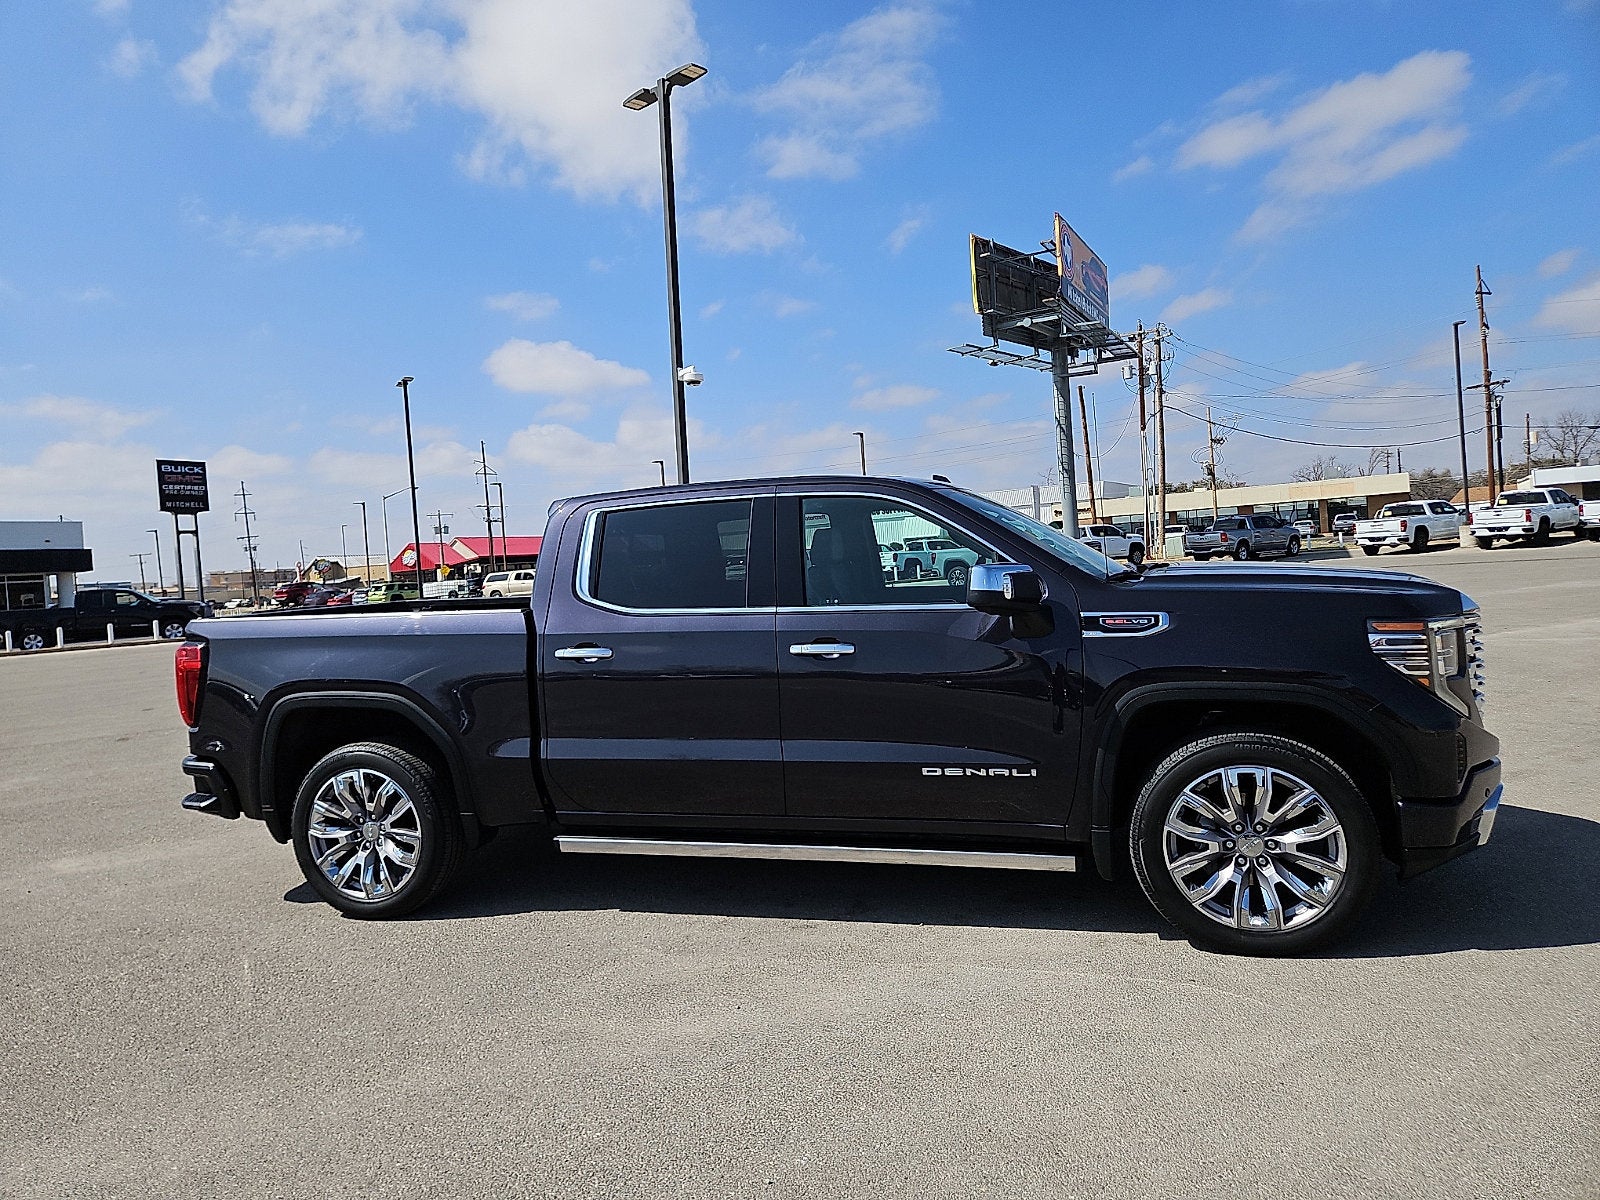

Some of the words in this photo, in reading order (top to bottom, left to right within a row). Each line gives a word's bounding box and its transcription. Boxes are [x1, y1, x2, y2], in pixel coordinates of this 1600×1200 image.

[161, 464, 205, 474] BUICK
[164, 474, 203, 483] GMC
[921, 767, 1037, 777] DENALI
